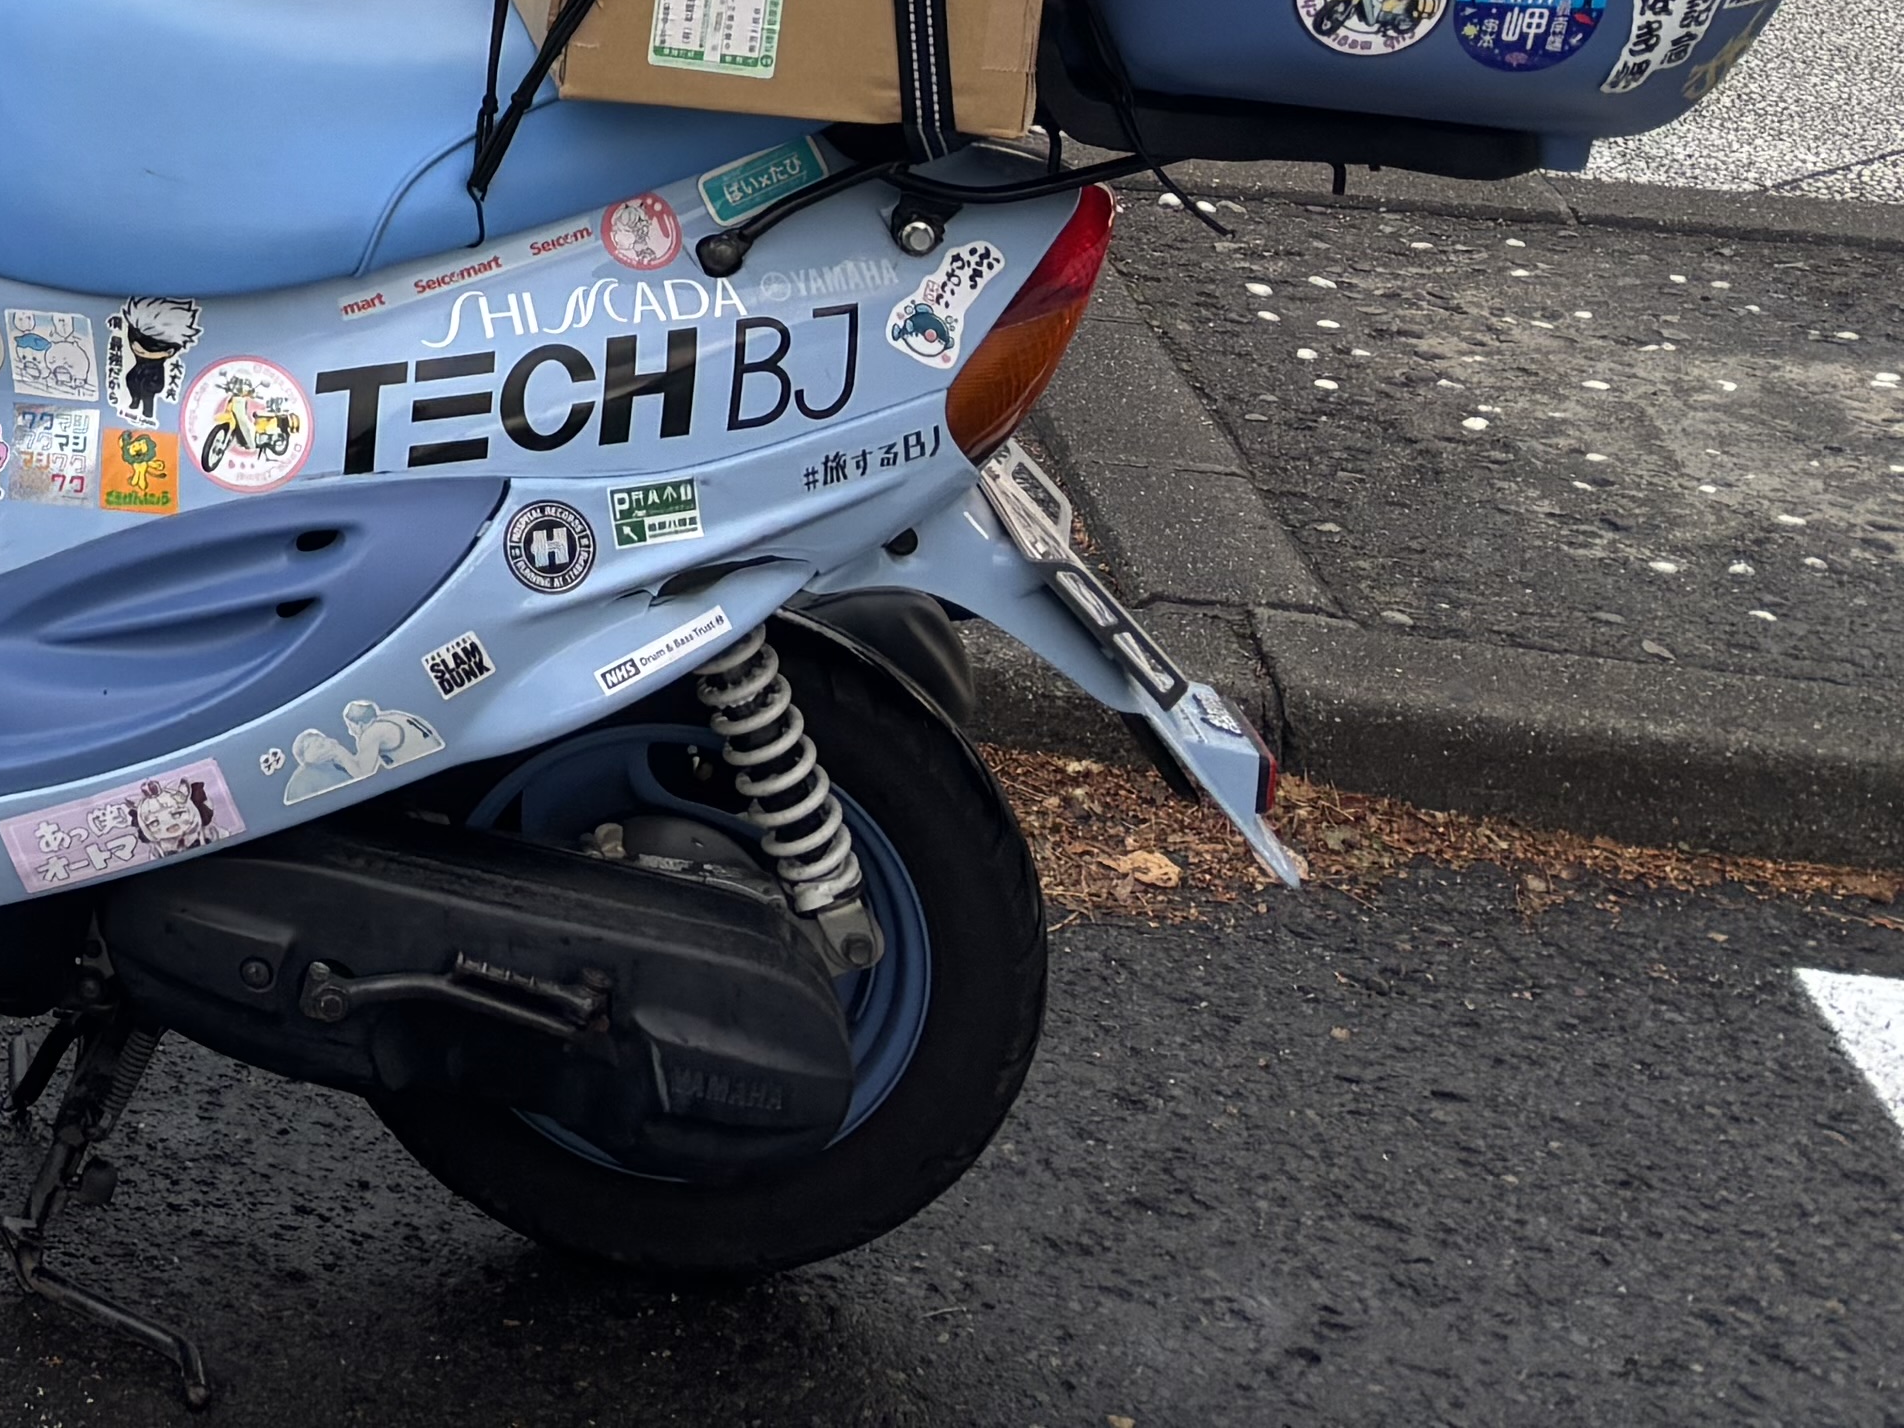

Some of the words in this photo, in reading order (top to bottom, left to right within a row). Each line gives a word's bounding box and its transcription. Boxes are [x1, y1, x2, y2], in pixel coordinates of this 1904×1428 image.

[413, 255, 503, 295] Seicomart
[790, 258, 899, 295] YAMAHA
[316, 328, 700, 476] TECH
[727, 303, 859, 433] BJ
[530, 526, 568, 567] H
[429, 643, 482, 680] SLAM
[601, 659, 639, 691] NHS
[665, 639, 674, 654] &
[693, 619, 716, 640] Trust
[436, 660, 491, 696] DUNK
